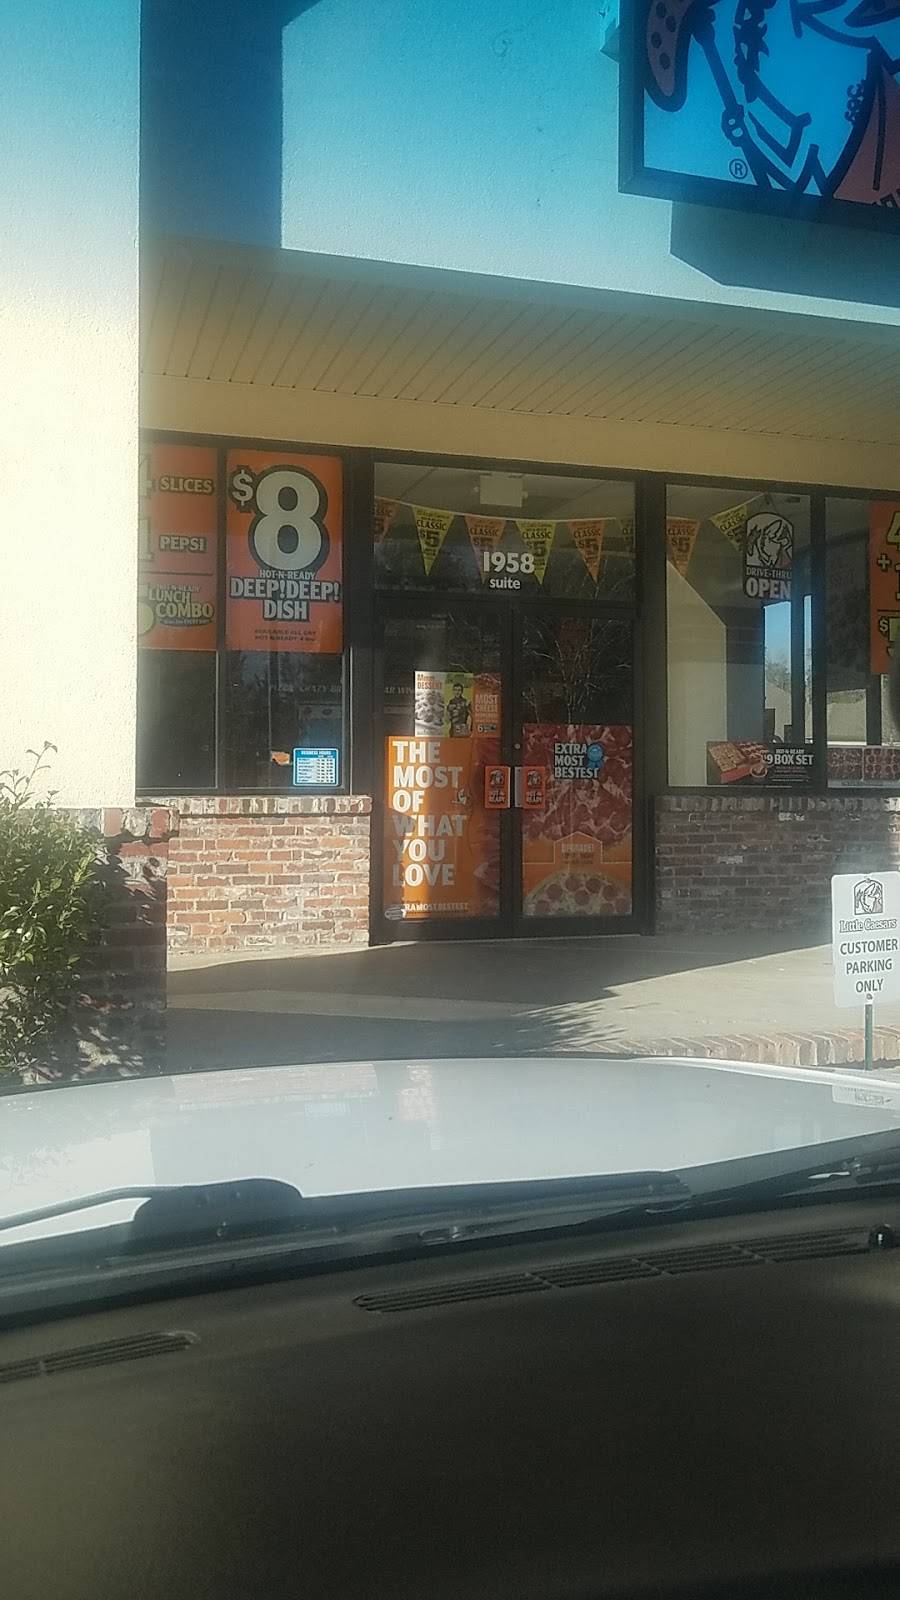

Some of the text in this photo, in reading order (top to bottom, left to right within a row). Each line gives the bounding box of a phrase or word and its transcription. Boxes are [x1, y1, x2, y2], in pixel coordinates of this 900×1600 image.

[160, 476, 213, 493] SLICES
[416, 519, 448, 531] CLASSIC
[469, 527, 499, 537] CLASSIC
[667, 527, 696, 537] CLASSIC
[420, 529, 441, 548] $5
[522, 530, 552, 540] CLASSIC
[573, 528, 601, 539] CLASSIC
[159, 536, 204, 551] PEPSI
[483, 551, 535, 574] 1958
[259, 569, 316, 580] HOT-N-READY
[746, 567, 792, 579] DRIVE-THRU
[489, 577, 521, 589] suite
[745, 577, 792, 600] OPEN
[148, 588, 192, 604] LUNCH
[155, 602, 214, 618] COMBO
[264, 600, 308, 620] DISH
[475, 695, 499, 704] MOST
[393, 741, 441, 763] THE
[555, 743, 587, 754] EXTRA
[555, 755, 585, 766] MOST
[775, 755, 795, 766] BOX
[796, 755, 814, 766] SET
[393, 766, 463, 788] MOST
[554, 767, 600, 779] BESTEST
[392, 790, 425, 813] OF
[392, 815, 467, 837] WHAT
[393, 839, 446, 862] YOU
[393, 864, 455, 887] LOVE
[840, 918, 897, 933] Little Caesars
[840, 938, 898, 955] CUSTOMER
[846, 958, 893, 975] PARKING
[856, 978, 883, 993] ONLY
